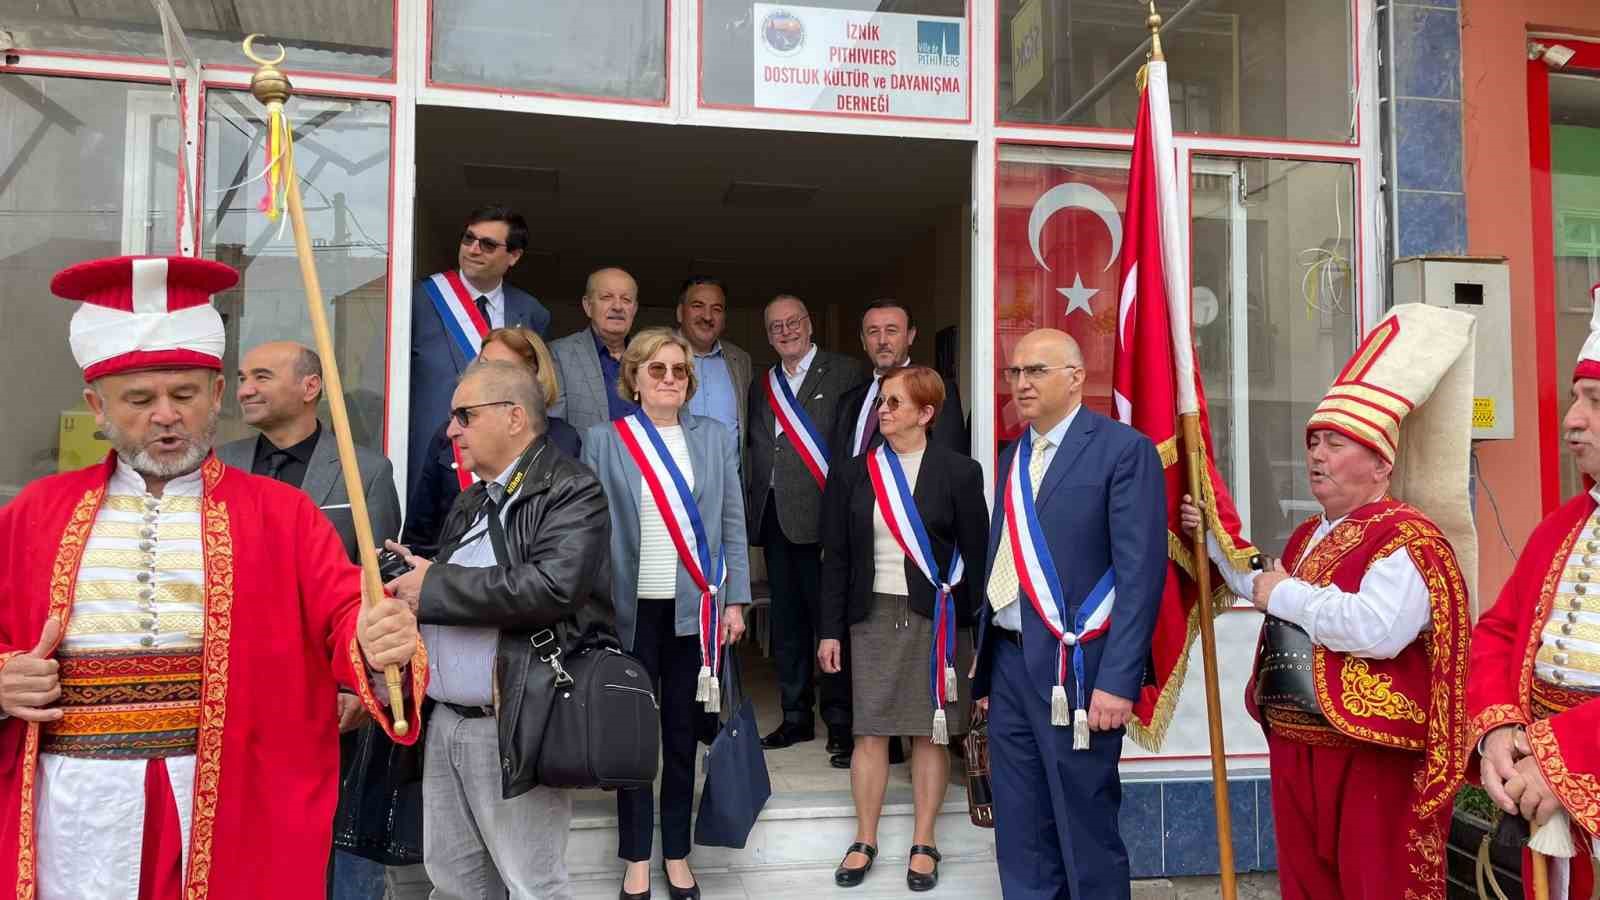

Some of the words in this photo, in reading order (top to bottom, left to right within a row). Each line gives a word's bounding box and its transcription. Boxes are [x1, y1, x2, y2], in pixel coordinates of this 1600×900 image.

[846, 19, 880, 41] İZNİK
[829, 46, 897, 66] PITHIVIERS
[918, 54, 960, 68] PITHIVIERS
[764, 66, 819, 84] DOSTLUK
[824, 69, 869, 89] KÜLTÜR
[873, 76, 886, 89] ve
[890, 74, 960, 95] DAYANIŞMA
[836, 94, 889, 113] DERNEĞİ
[506, 471, 523, 496] Nikon
